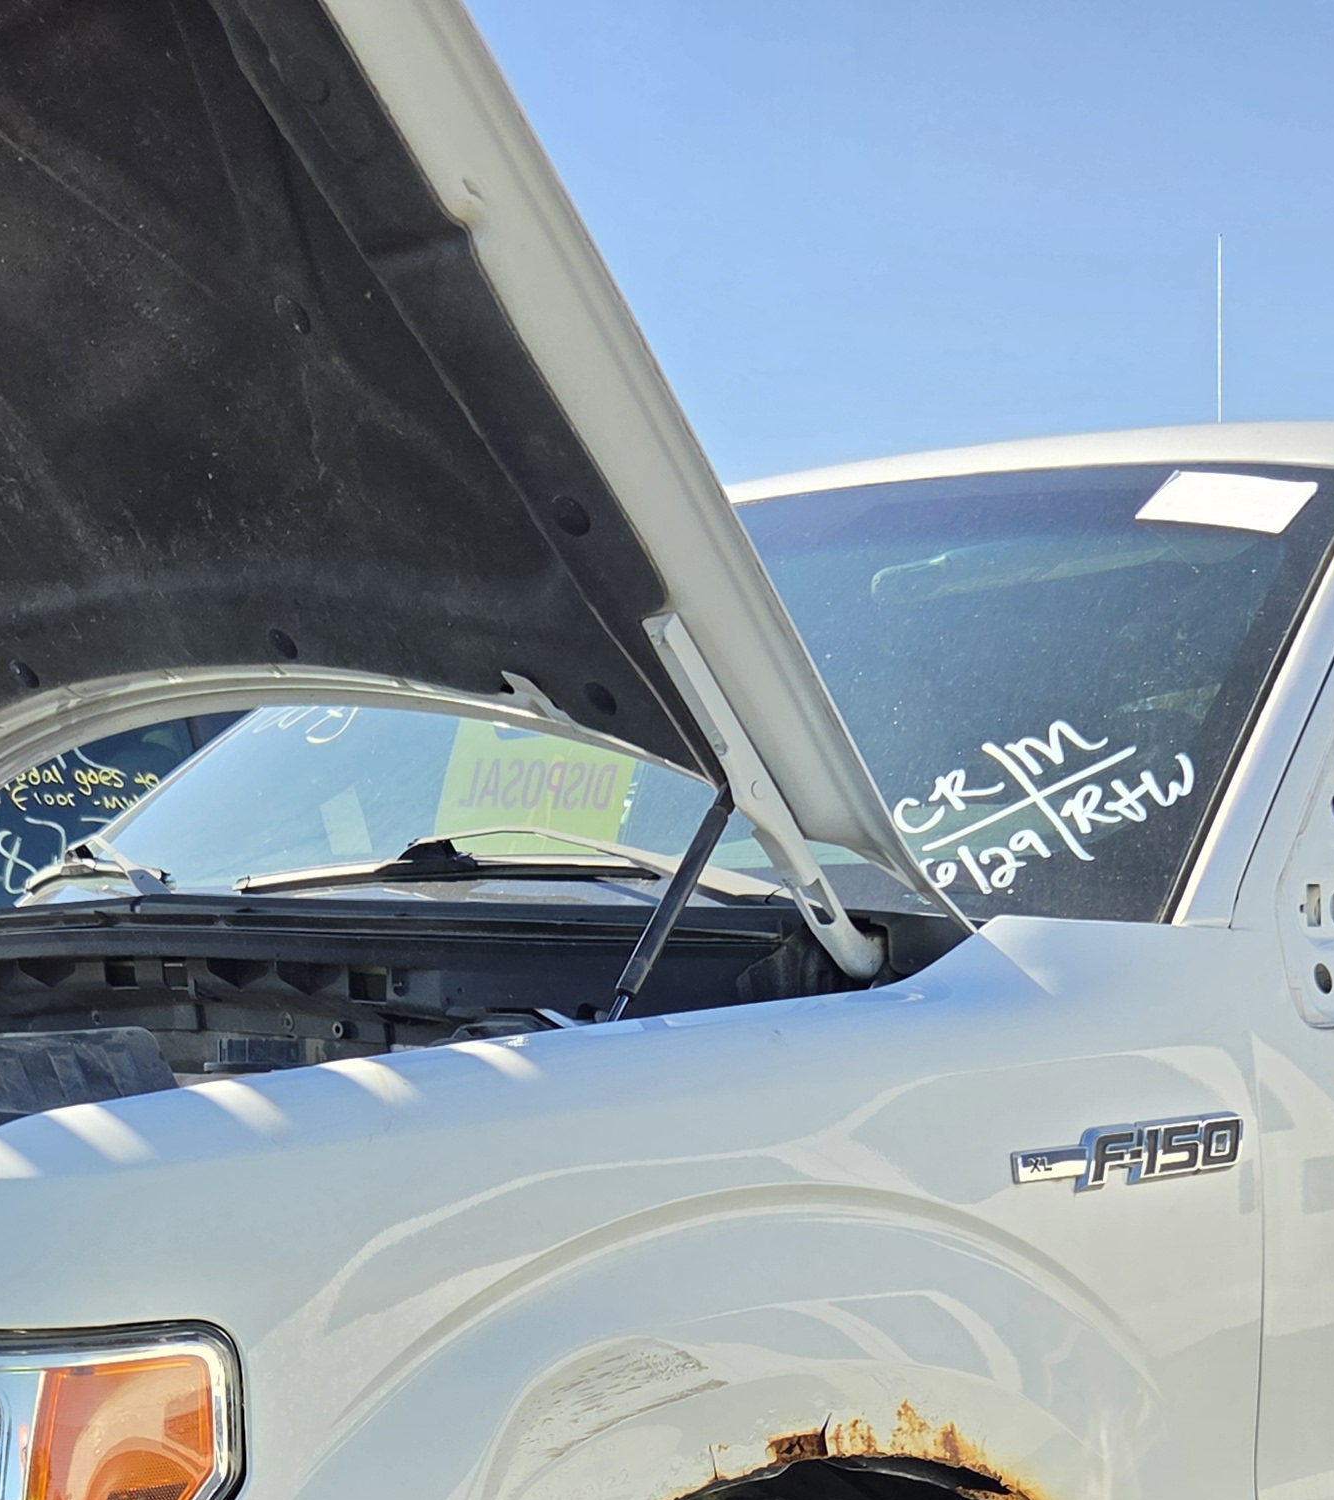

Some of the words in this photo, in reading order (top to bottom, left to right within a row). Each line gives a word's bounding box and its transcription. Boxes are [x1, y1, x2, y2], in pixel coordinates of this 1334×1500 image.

[4, 764, 65, 792] edal
[74, 768, 124, 796] goes
[1028, 1157, 1053, 1174] XL
[1079, 1112, 1243, 1192] F-150
